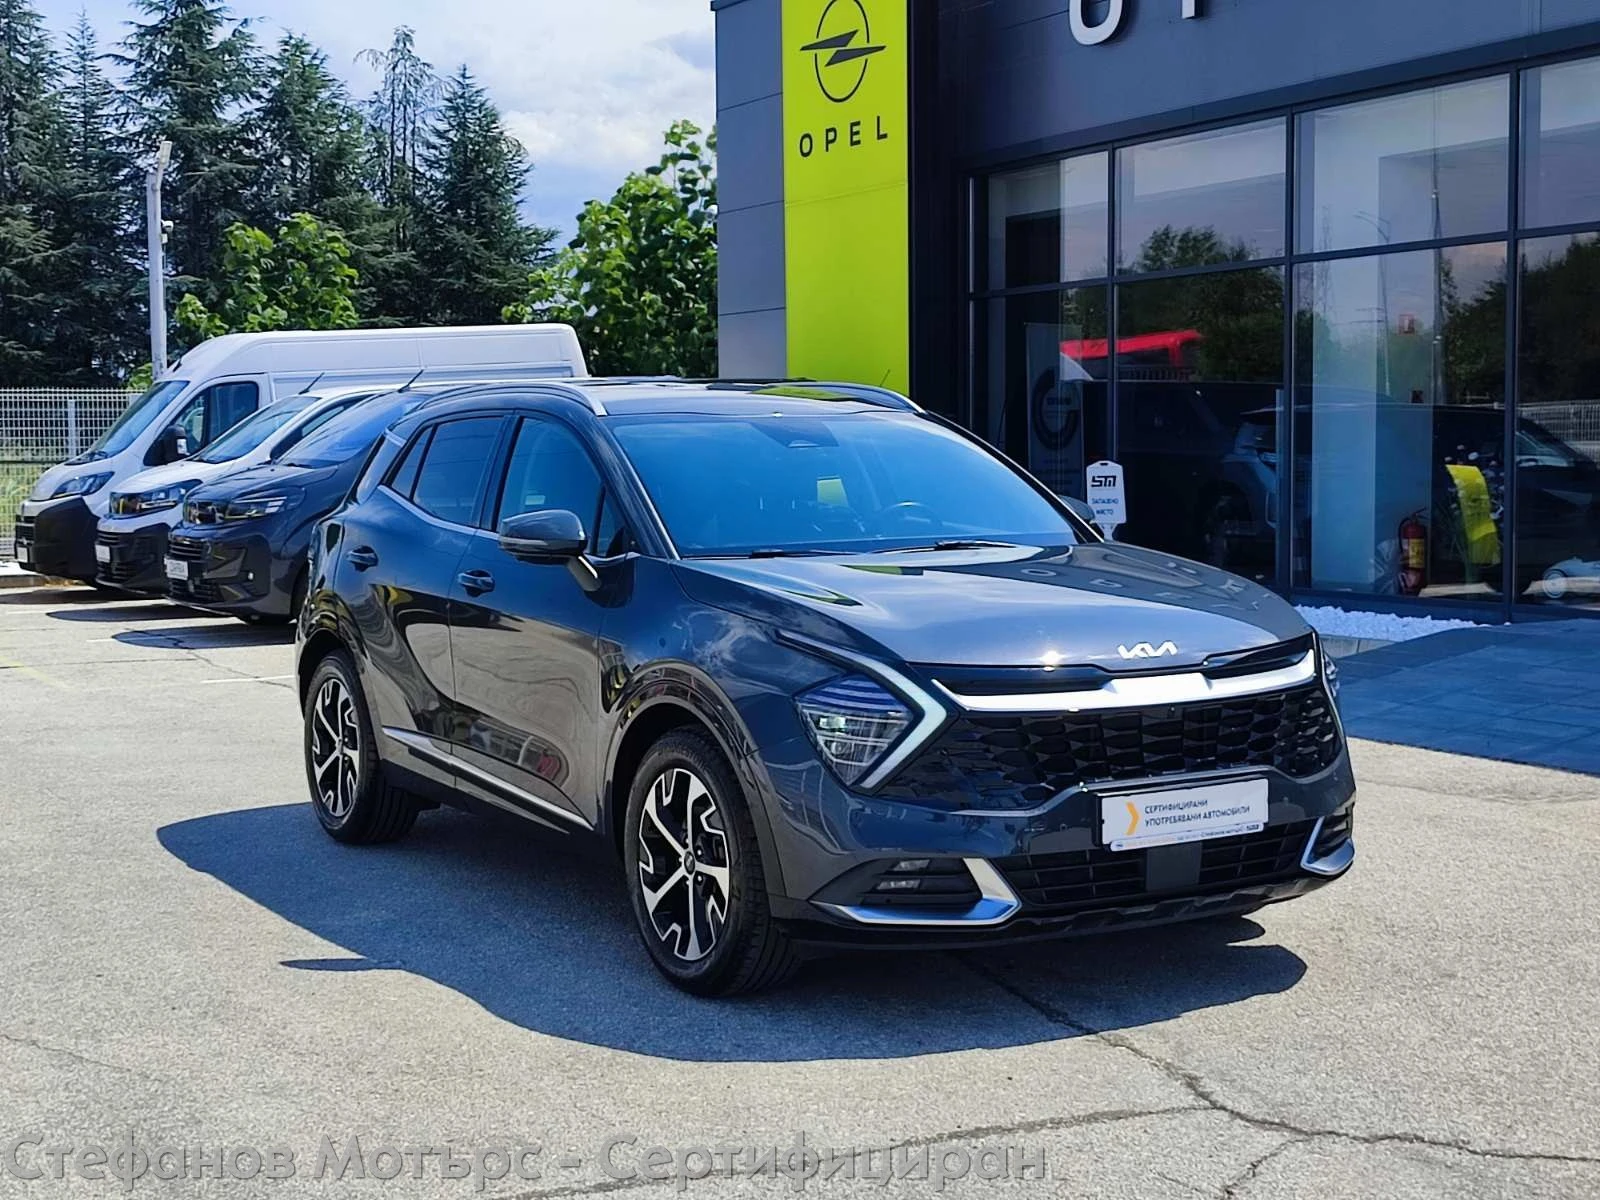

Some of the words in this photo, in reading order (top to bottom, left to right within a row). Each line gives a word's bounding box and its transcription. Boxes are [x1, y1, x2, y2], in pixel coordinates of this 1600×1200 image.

[799, 115, 888, 158] OPEL
[1116, 640, 1178, 660] KIA
[1144, 799, 1208, 815] СЕРТИФИЦИРАНИ
[1144, 812, 1201, 827] УПОТРЕБЯВАНИ
[1202, 805, 1250, 820] АВТОМОБИЛИ
